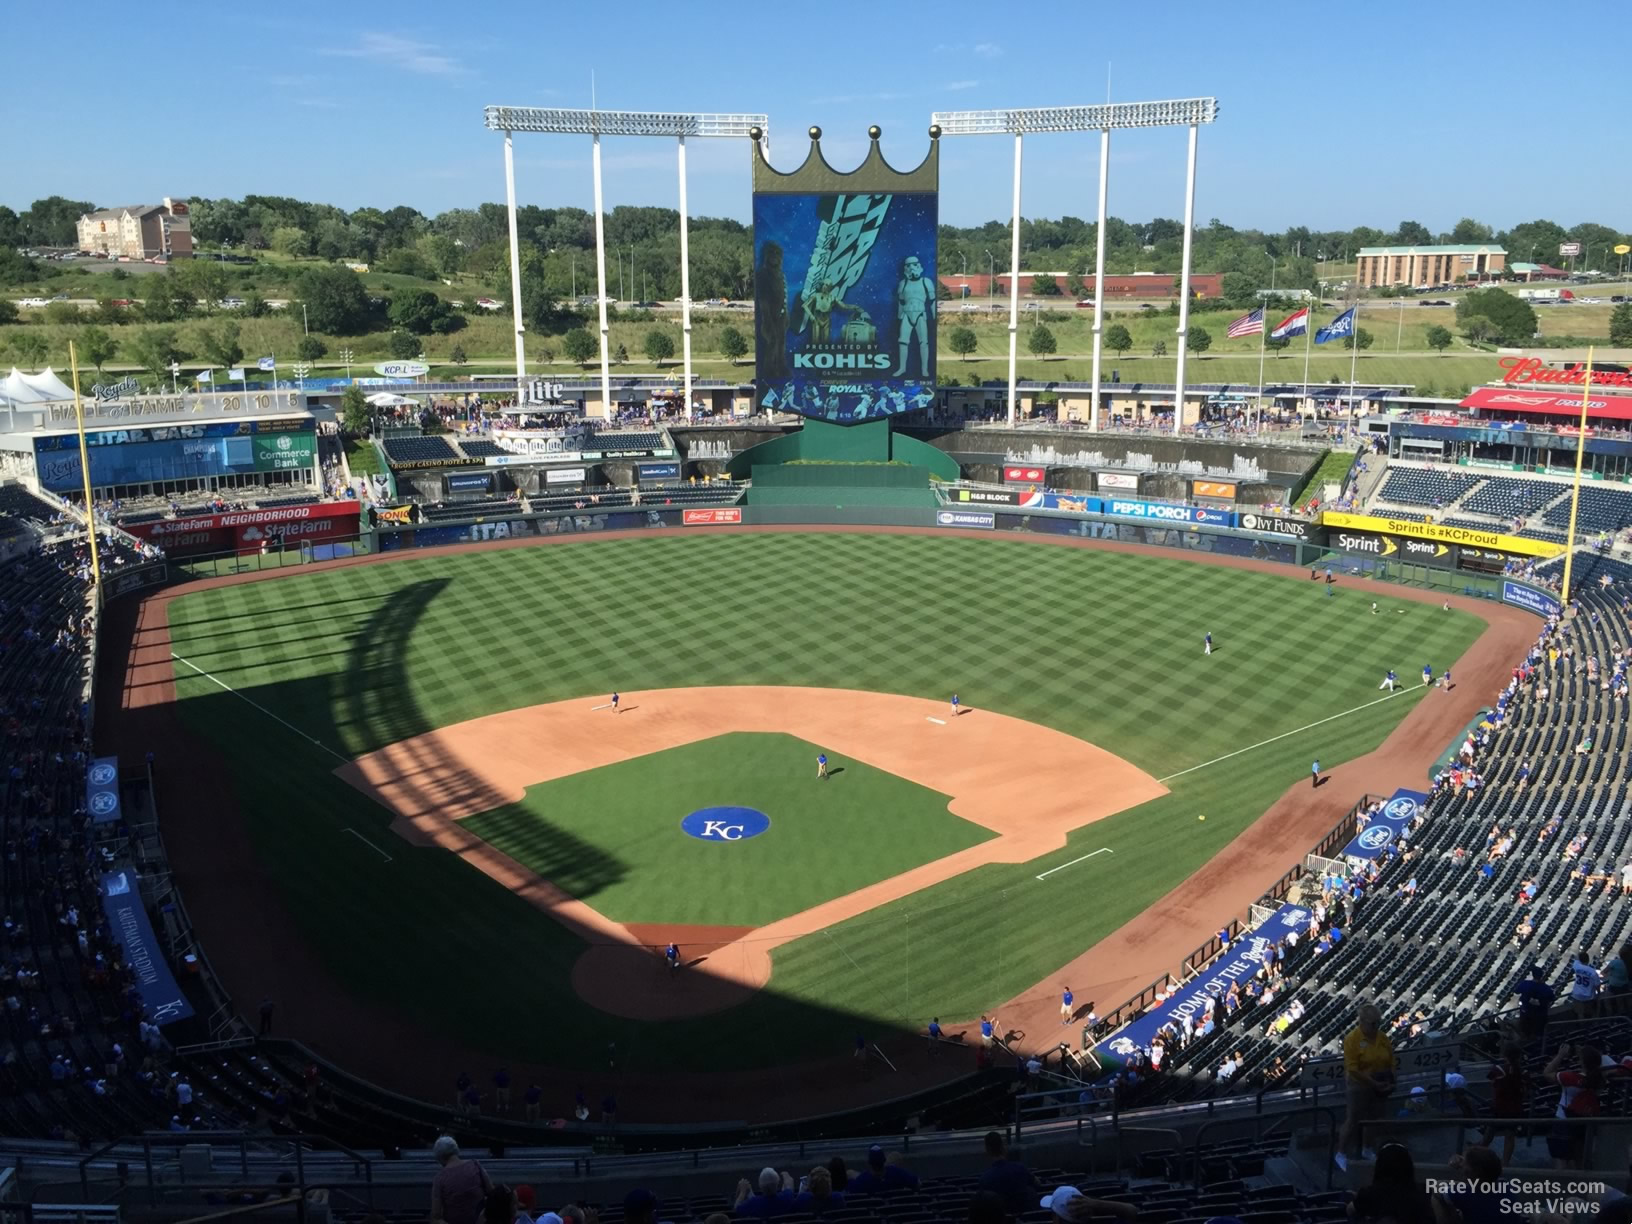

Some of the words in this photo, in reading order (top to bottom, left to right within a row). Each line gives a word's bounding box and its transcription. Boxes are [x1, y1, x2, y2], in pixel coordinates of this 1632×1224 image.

[794, 353, 891, 369] KOHL'S
[92, 375, 141, 403] Royals
[527, 381, 564, 404] Lite
[828, 385, 864, 394] ROYAL
[129, 397, 186, 417] FAME
[222, 396, 241, 411] 20
[255, 394, 271, 409] 10
[288, 393, 298, 407] 5
[260, 448, 311, 460] Commerce
[274, 458, 299, 468] Bank
[417, 460, 443, 468] CASINO
[443, 458, 465, 466] HOTEL
[986, 494, 1011, 502] BLOCK
[221, 508, 310, 526] NEIGHBORHOOD
[376, 509, 409, 521] SONIC
[1113, 502, 1145, 516] PEPSI
[1147, 505, 1191, 521] PORCH
[165, 519, 213, 533] StateFarm
[955, 515, 980, 523] KANSAS
[980, 517, 993, 525] CITY
[1256, 516, 1272, 531] IVY
[1274, 519, 1305, 535] FUNDS
[1388, 520, 1424, 535] Sprint
[1426, 525, 1436, 536] is
[1438, 528, 1498, 545] #KCProud
[1338, 533, 1380, 553] Sprint
[1406, 540, 1435, 554] Sprint
[1462, 549, 1475, 558] Sprint
[1389, 800, 1413, 817] Ford
[700, 820, 744, 841] KC
[1364, 828, 1389, 846] Ford
[117, 906, 143, 950] KAUFFMAN
[130, 946, 158, 986] STADIUM
[1575, 974, 1591, 988] 35
[1168, 990, 1211, 1022] HOME
[1204, 975, 1227, 996] OF
[1217, 960, 1250, 982] THE
[1414, 1052, 1440, 1067] 423
